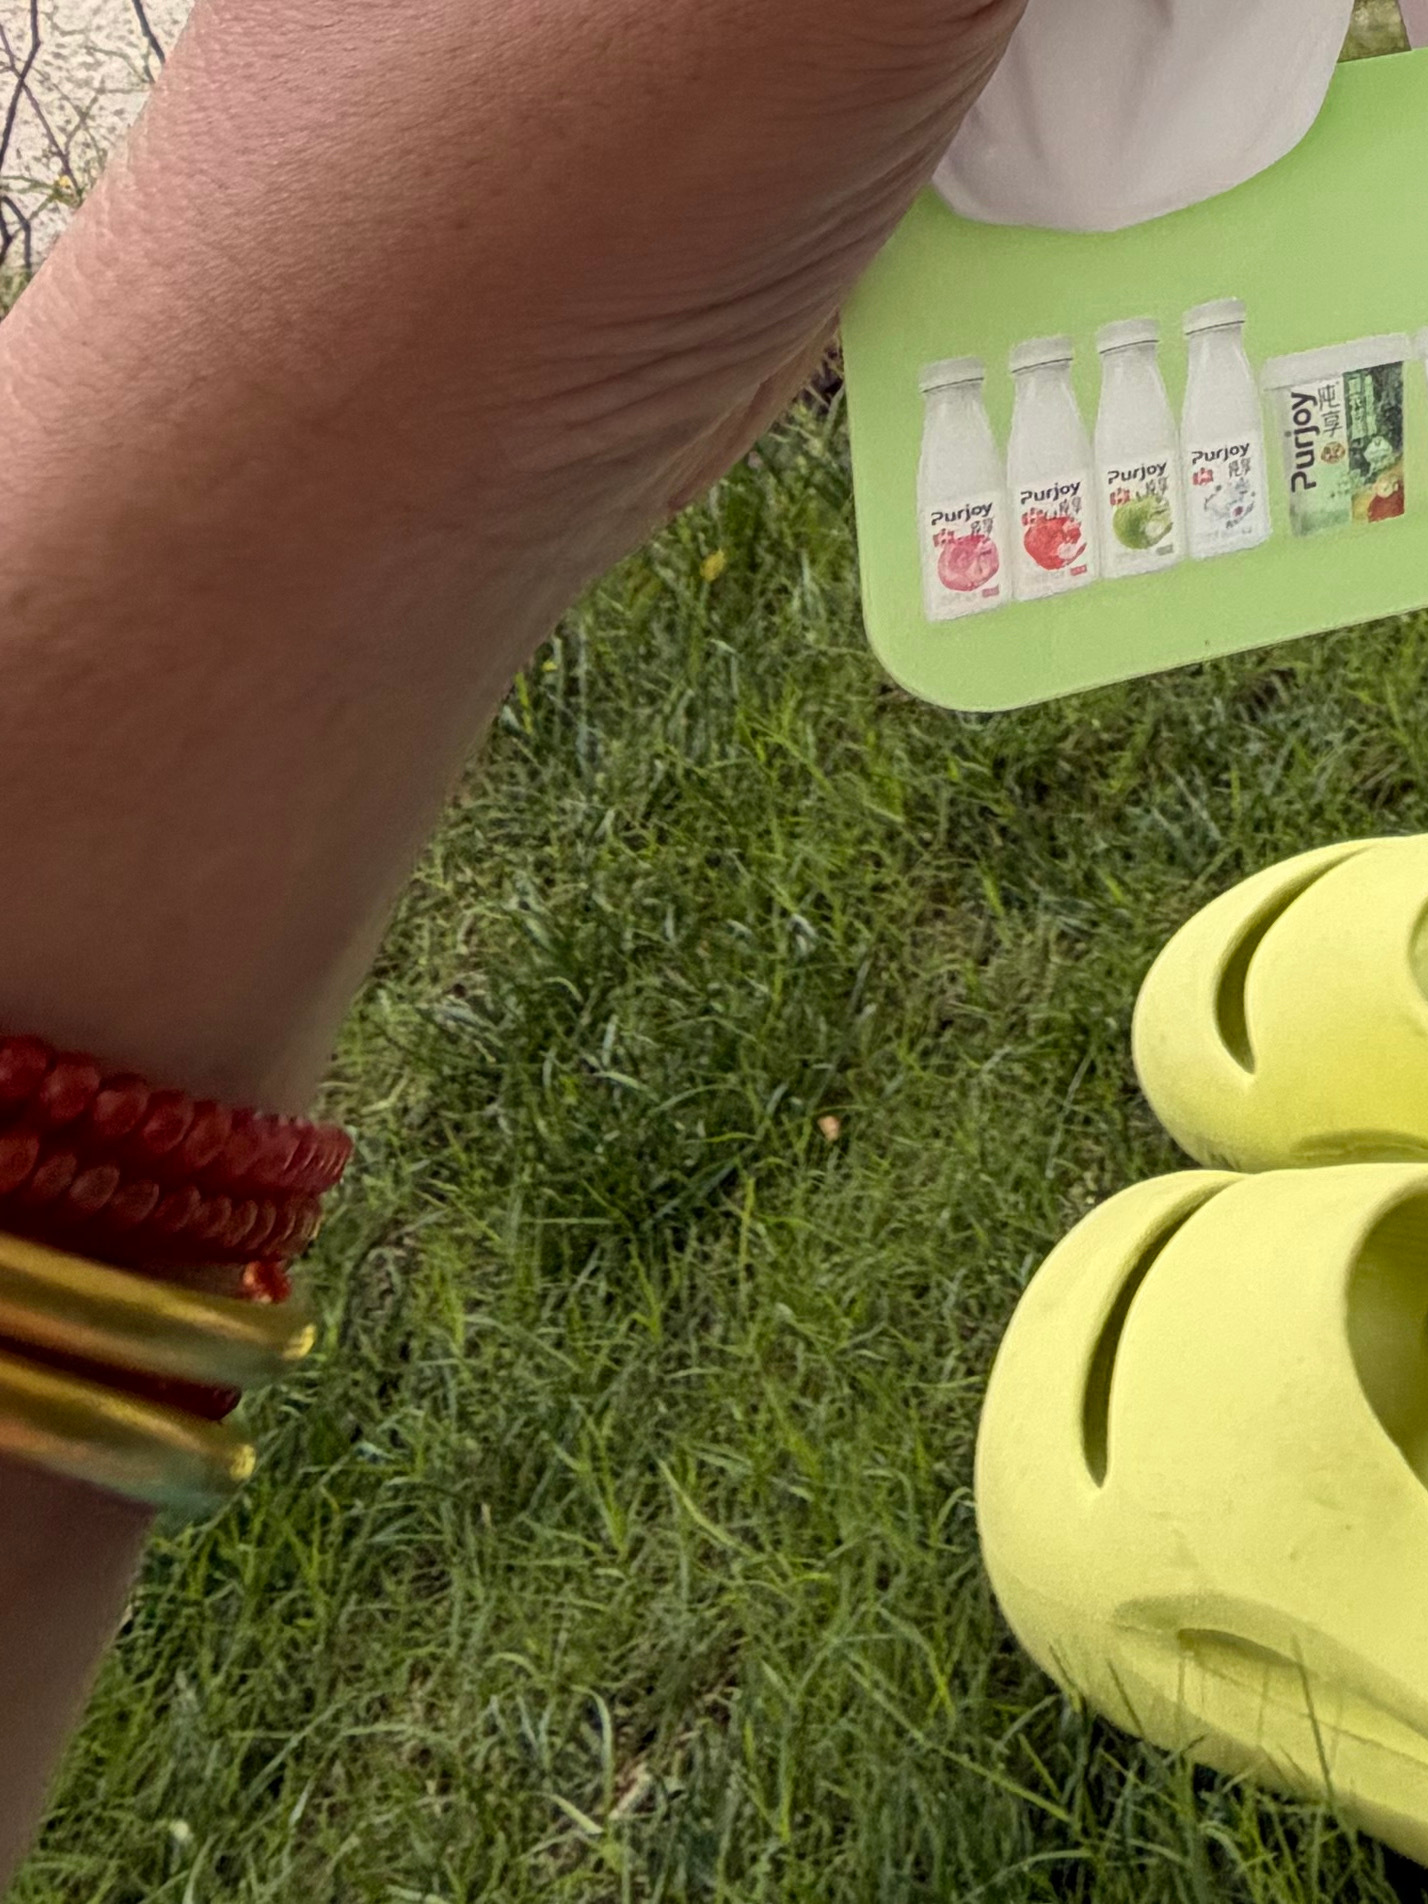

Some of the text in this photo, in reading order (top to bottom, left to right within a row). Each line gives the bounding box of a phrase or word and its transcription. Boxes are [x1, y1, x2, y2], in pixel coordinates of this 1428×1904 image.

[1191, 442, 1251, 466] Purjoy
[1284, 391, 1321, 493] Purjoy
[1107, 461, 1168, 485] Purjoy
[1020, 481, 1081, 505] Purjoy
[930, 502, 993, 526] Purjoy
